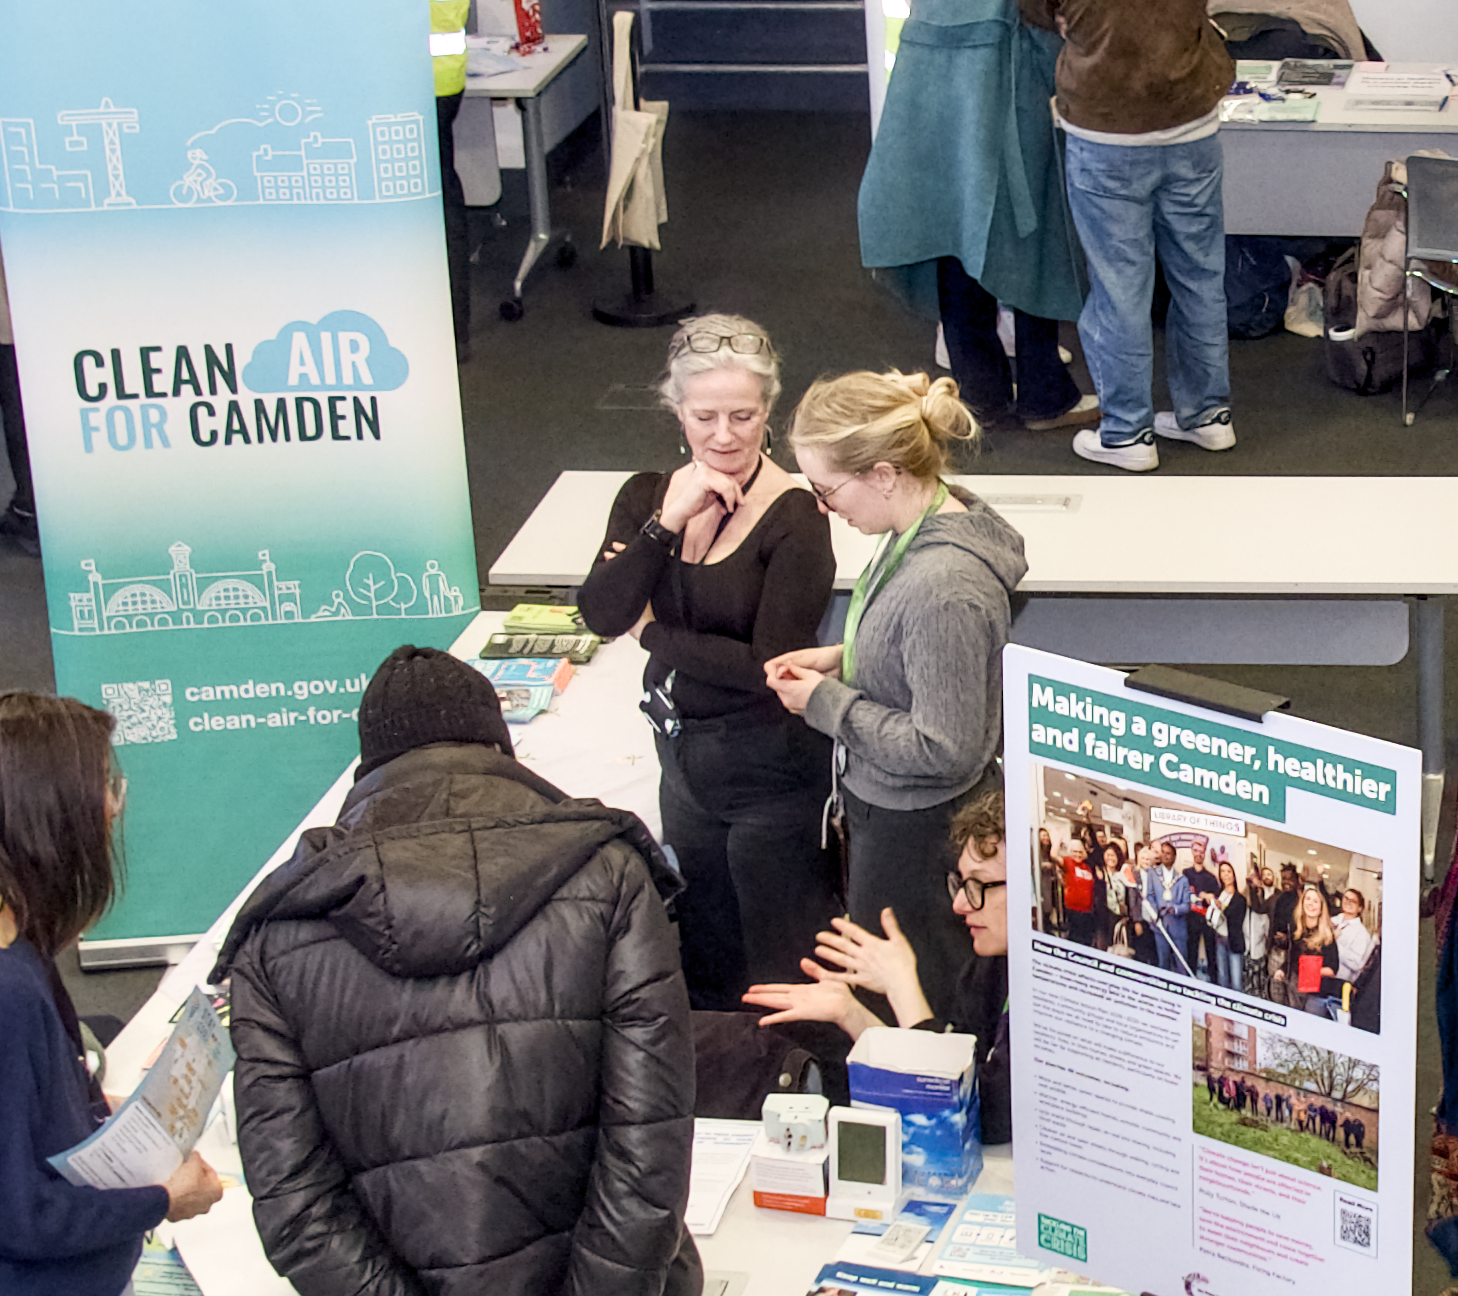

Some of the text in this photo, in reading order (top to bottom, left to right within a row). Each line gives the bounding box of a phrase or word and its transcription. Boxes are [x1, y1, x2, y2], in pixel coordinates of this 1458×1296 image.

[73, 331, 374, 403] CLEAN AIR
[79, 396, 381, 454] FOR CAMDEN
[185, 673, 370, 702] camden.gov.uk
[188, 707, 360, 732] clean-air-for-c
[1031, 683, 1391, 802] Making a greener, healthier
[1031, 723, 1270, 805] and fairer Camden
[1154, 811, 1240, 832] LIBRARY OF THINGS
